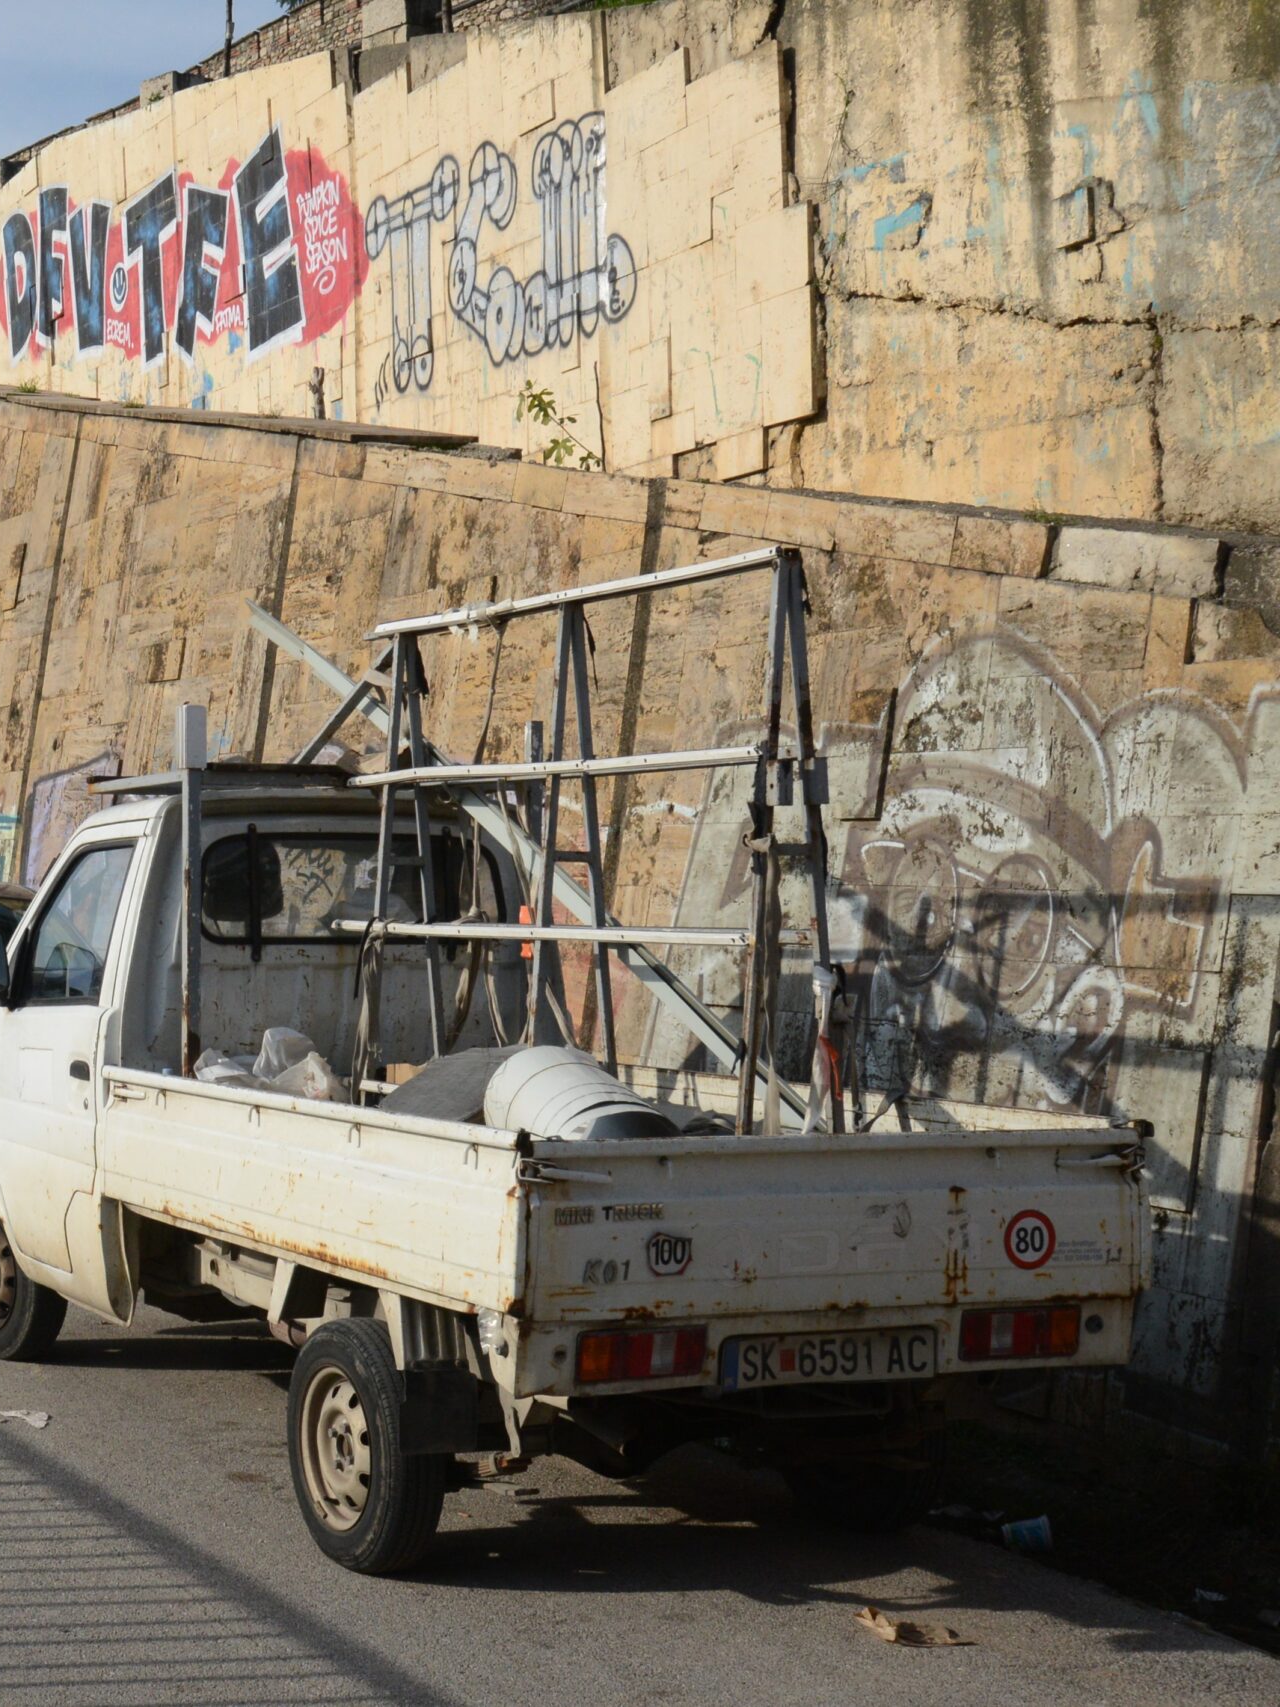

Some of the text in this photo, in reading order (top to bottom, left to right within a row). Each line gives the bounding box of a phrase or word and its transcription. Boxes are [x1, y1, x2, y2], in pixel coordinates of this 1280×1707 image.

[304, 207, 338, 246] SPICE
[305, 228, 348, 274] SEASON
[553, 1201, 665, 1226] MINI TRUCK
[651, 1237, 687, 1266] 100
[1015, 1225, 1044, 1254] 80
[742, 1334, 928, 1382] SK 6591 AC
